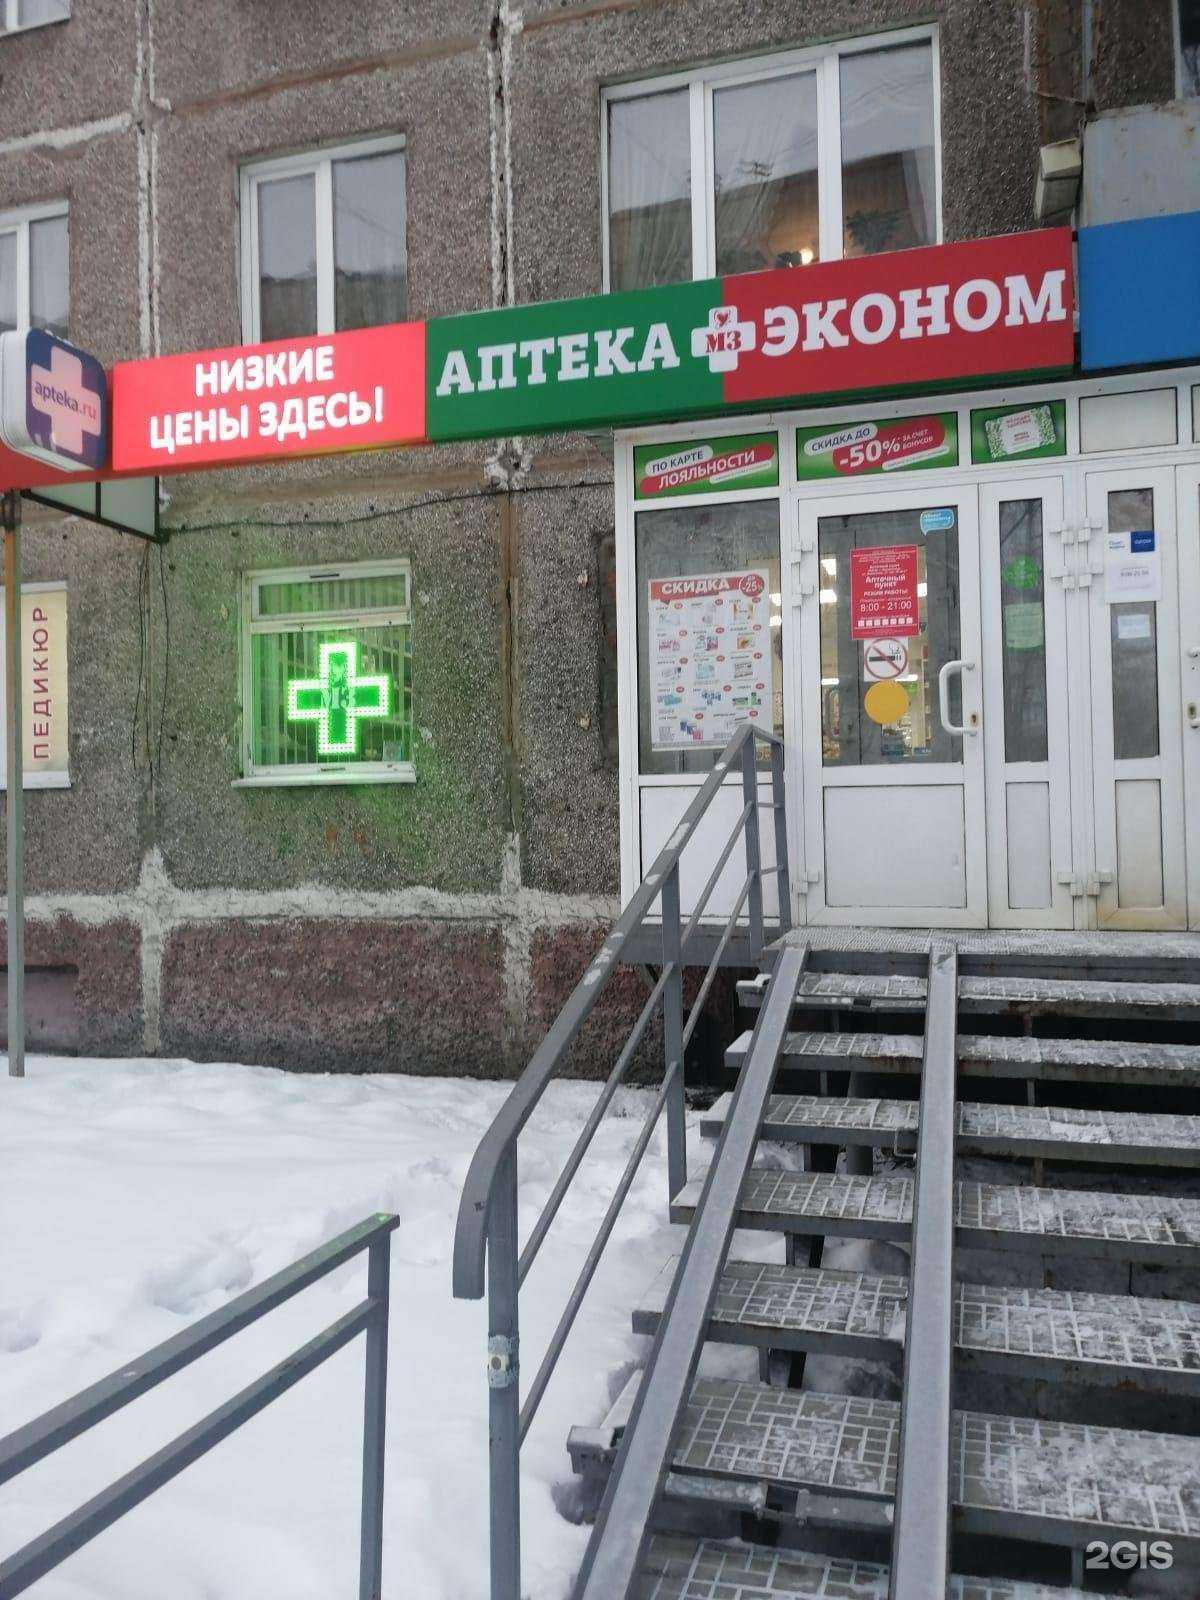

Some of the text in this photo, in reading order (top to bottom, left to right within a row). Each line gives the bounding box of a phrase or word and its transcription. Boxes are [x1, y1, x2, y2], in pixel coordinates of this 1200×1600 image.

[436, 322, 681, 397] АПТЕКА
[760, 269, 1067, 357] ЭКОНОМ
[195, 345, 335, 397] НИЗКИЕ
[35, 381, 97, 420] apteka.ru
[150, 386, 385, 455] ЦЕНЫ ЗДЕСЬ!
[811, 427, 871, 452] СКИДКА ДО
[652, 450, 704, 474] ПО КАРТЕ
[658, 450, 756, 490] ЛОЯЛЬНОСТИ
[661, 578, 731, 595] СКИДКА
[860, 603, 880, 613] 8:00
[887, 601, 912, 611] 21:00
[32, 607, 52, 759] ПЕДИКЮР
